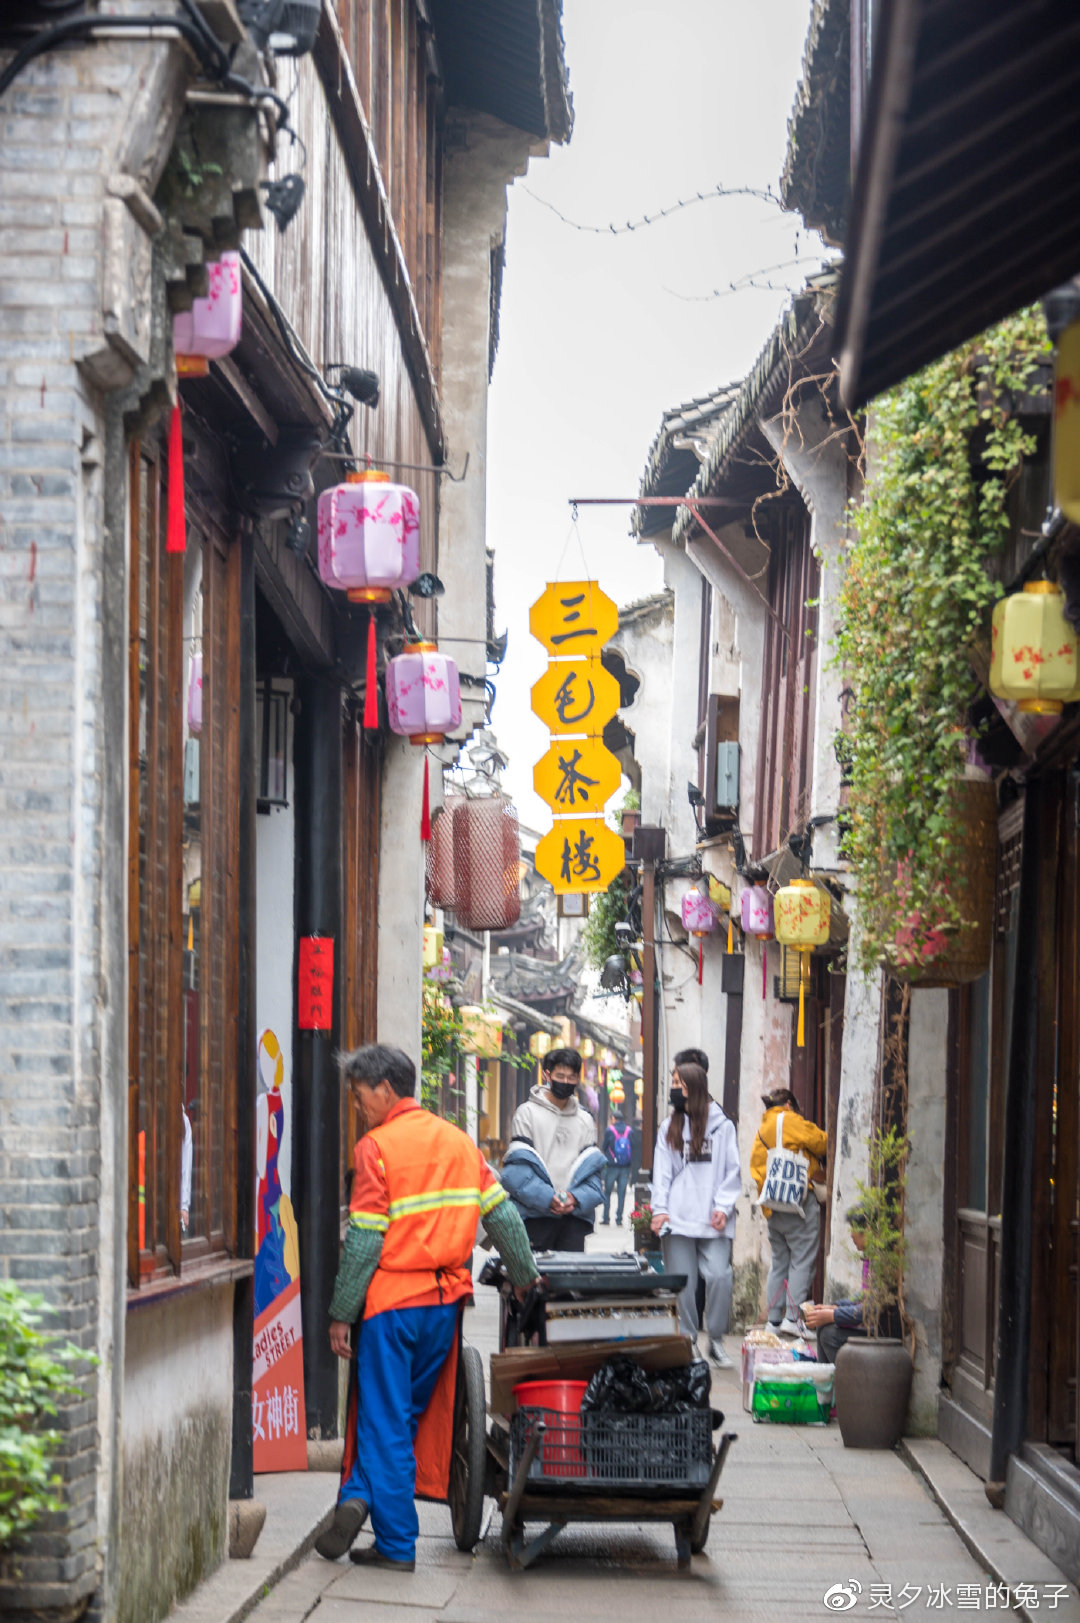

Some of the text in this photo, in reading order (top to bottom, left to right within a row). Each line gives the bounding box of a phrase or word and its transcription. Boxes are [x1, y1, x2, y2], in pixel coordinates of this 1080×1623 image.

[765, 1179, 804, 1205] NIM
[252, 1321, 284, 1362] adies
[265, 1326, 295, 1368] STREET
[252, 1385, 299, 1442] 女神街
